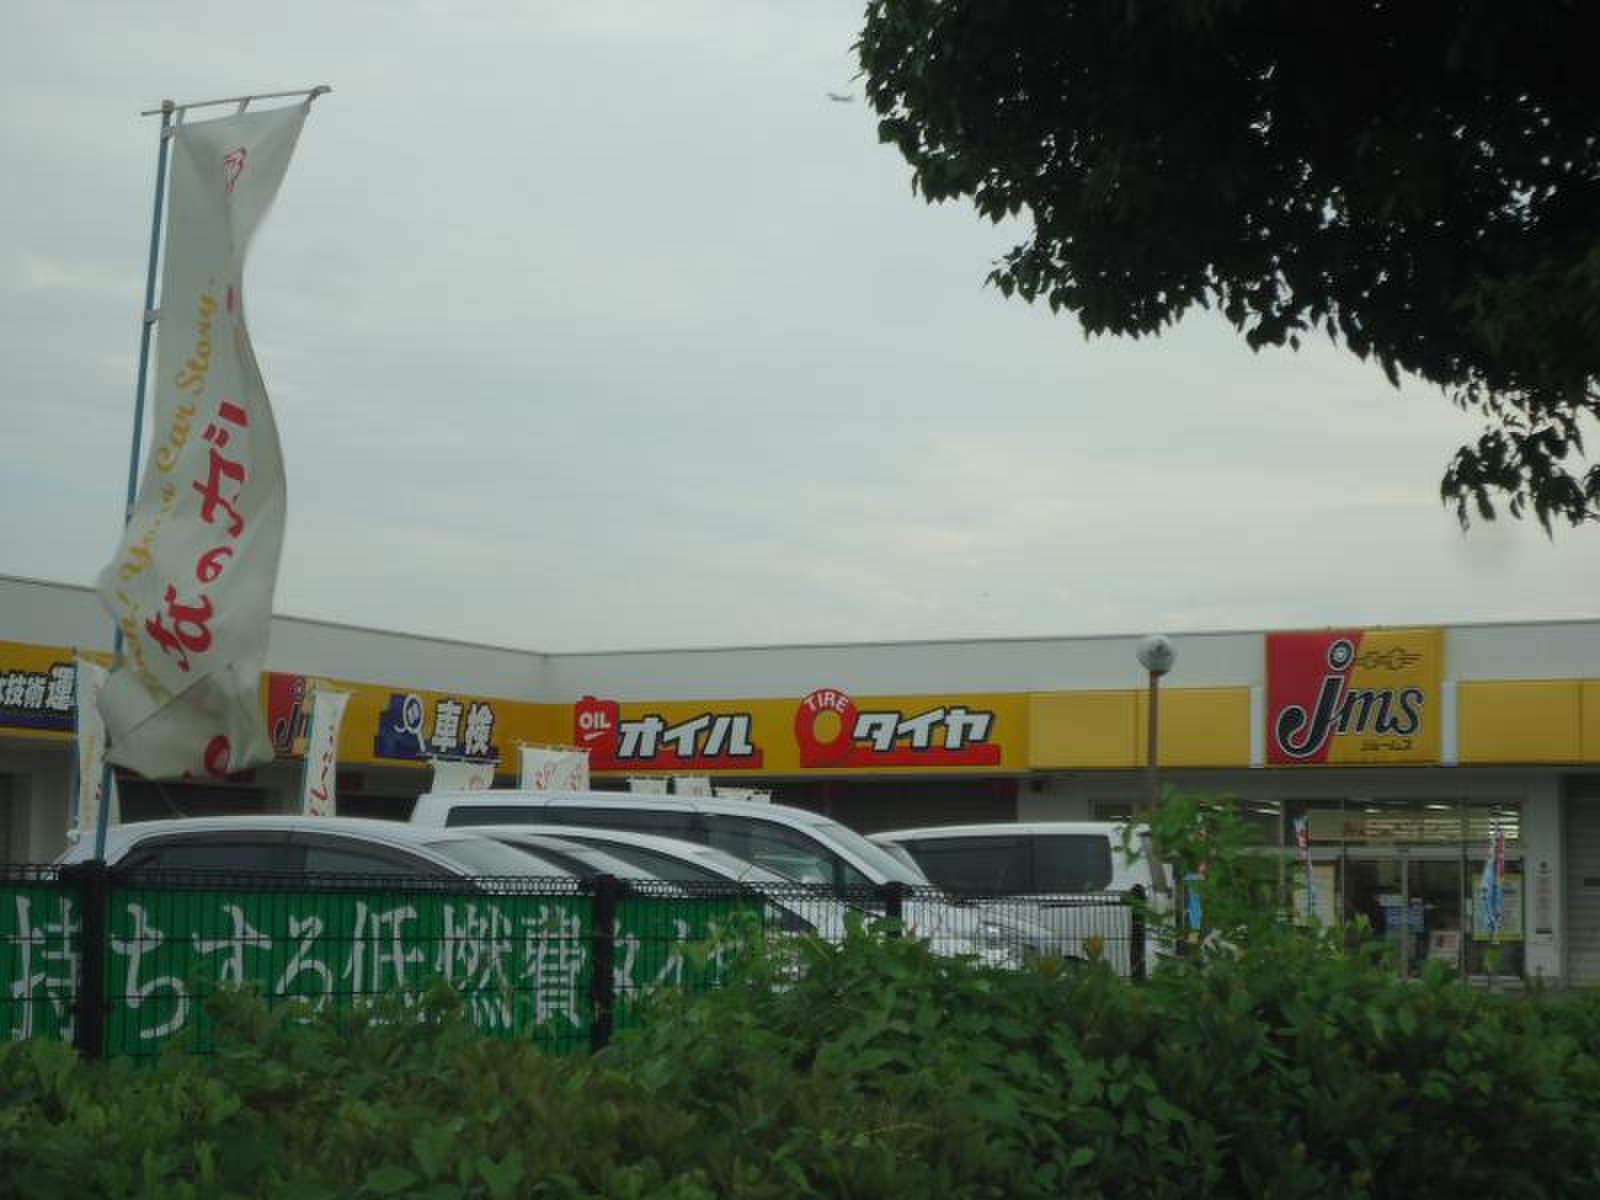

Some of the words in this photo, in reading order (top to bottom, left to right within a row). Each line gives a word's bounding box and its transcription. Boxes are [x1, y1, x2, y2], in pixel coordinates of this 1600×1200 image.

[578, 711, 612, 730] OIL
[803, 690, 850, 714] TIRE
[431, 699, 496, 756] 車検
[617, 712, 754, 758] オイル
[851, 706, 995, 752] タイヤ
